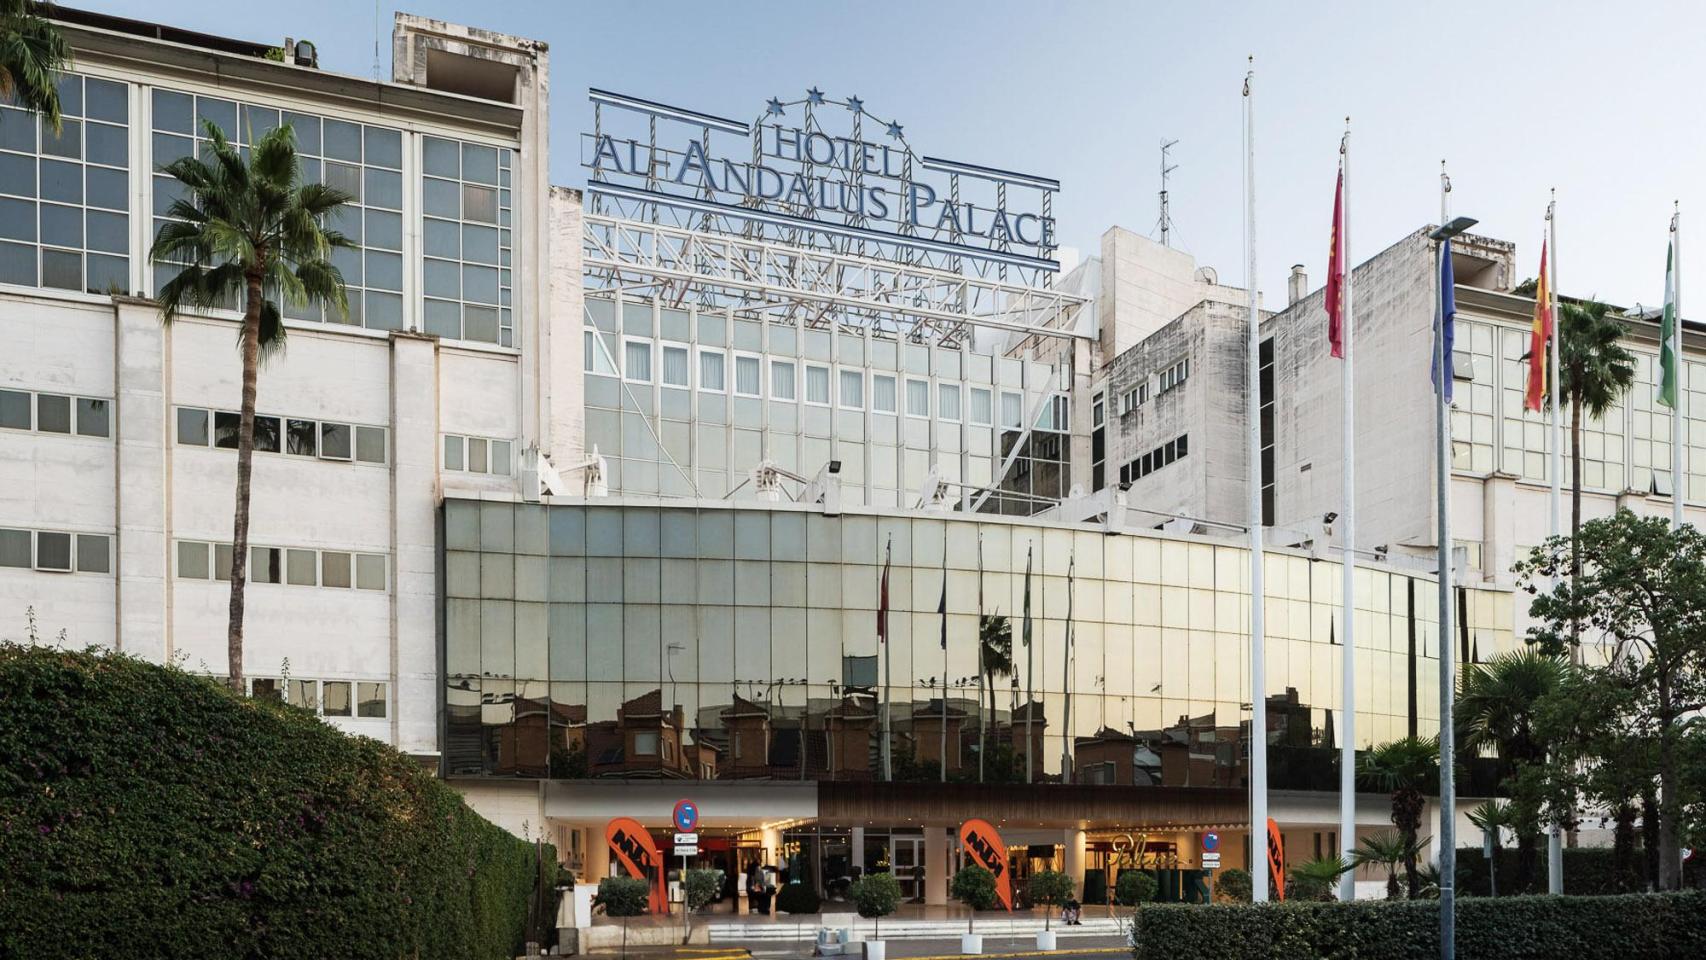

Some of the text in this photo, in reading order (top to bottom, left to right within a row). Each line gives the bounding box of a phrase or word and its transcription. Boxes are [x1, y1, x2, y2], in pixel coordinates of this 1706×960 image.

[773, 124, 902, 179] HOTEL
[909, 181, 1059, 250] PALACE
[1107, 834, 1188, 865] Palace
